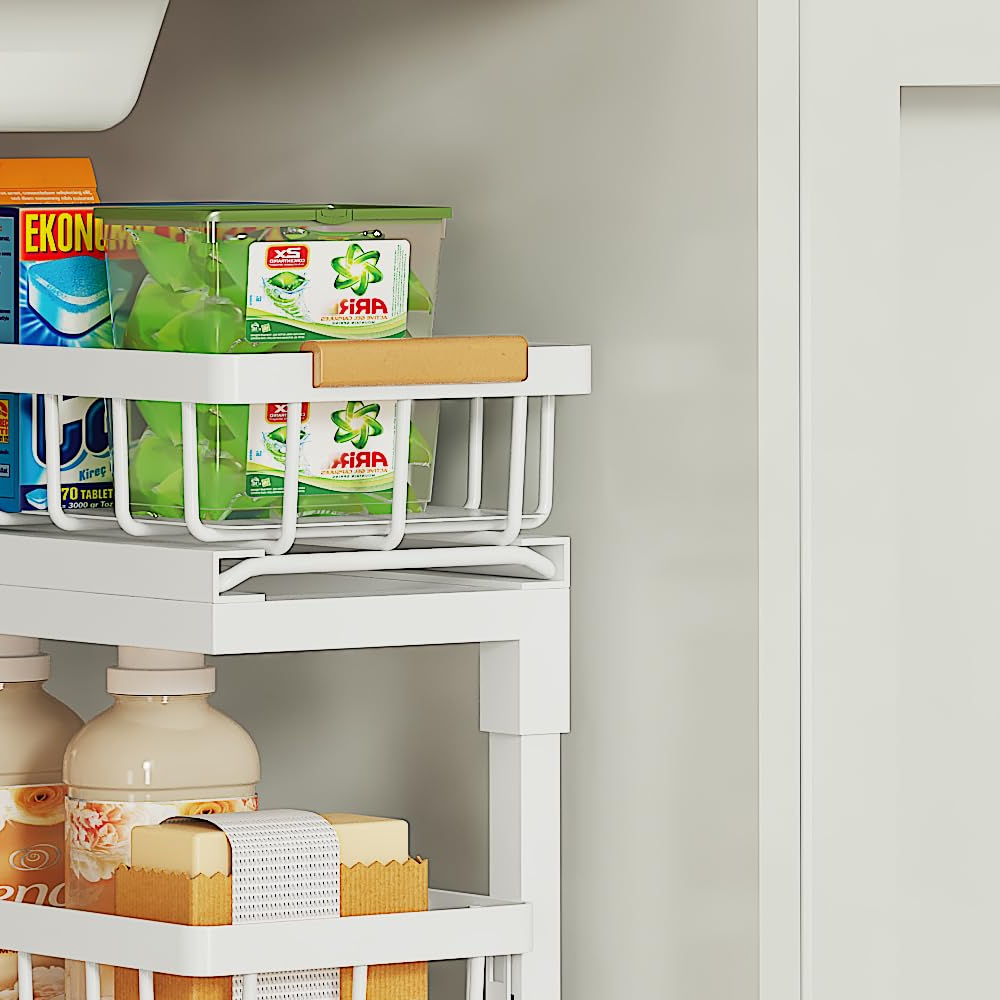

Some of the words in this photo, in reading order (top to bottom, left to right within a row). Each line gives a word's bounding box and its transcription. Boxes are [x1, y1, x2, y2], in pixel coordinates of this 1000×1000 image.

[79, 466, 106, 481] Kireç
[61, 487, 78, 500] 70
[81, 488, 113, 500] TABLET
